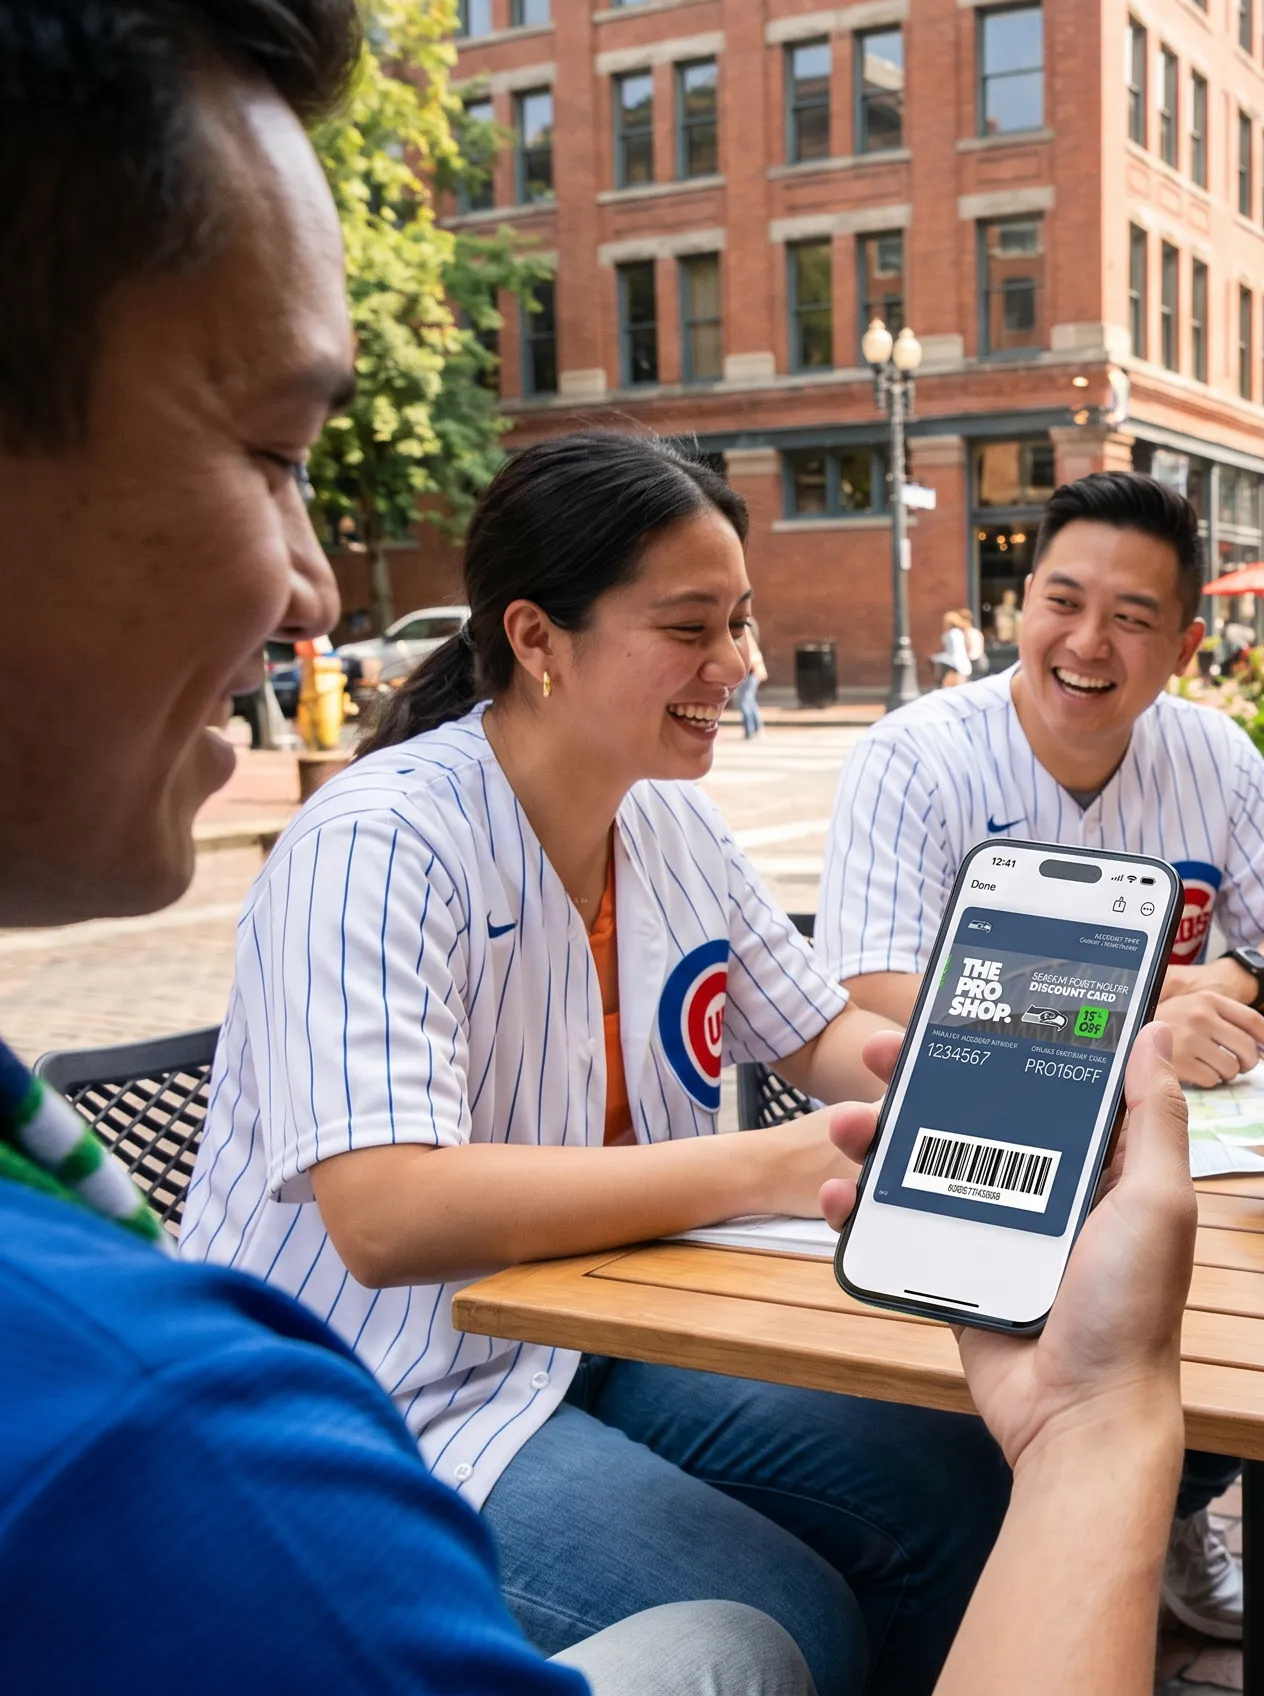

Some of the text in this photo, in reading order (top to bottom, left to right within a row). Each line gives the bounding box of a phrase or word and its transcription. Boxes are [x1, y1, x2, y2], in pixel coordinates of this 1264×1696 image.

[991, 857, 1017, 868] 12:41
[970, 879, 997, 892] Done
[962, 957, 1003, 981] THE
[955, 977, 1003, 1001] PRO
[1029, 981, 1117, 1003] DISCOUNT CARD
[948, 997, 1012, 1024] SHOP.
[927, 1042, 992, 1066] 1234567
